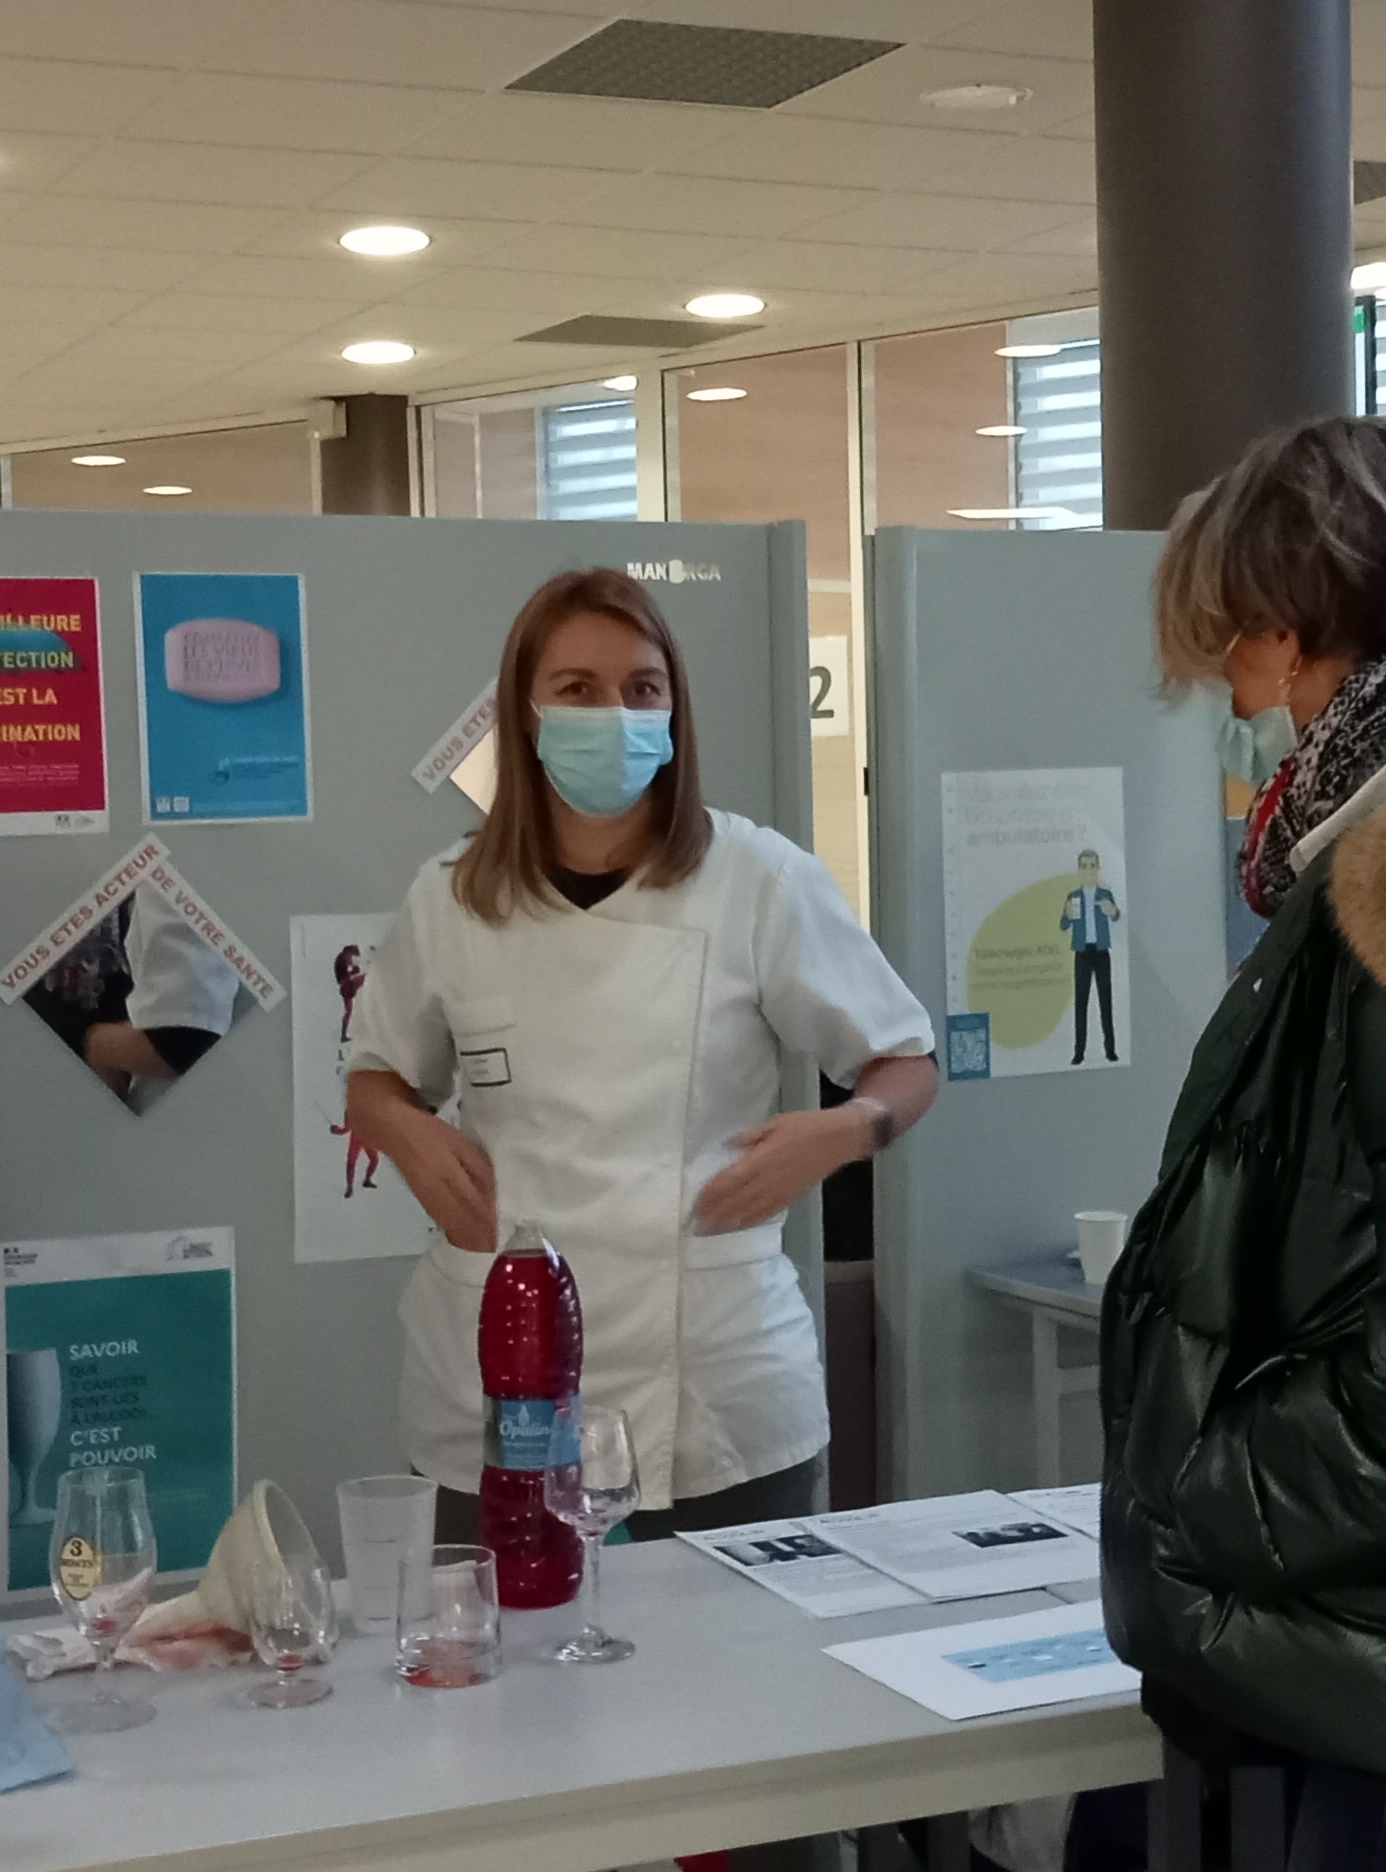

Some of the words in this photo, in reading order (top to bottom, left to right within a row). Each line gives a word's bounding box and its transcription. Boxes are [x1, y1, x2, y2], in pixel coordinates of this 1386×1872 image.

[32, 687, 58, 706] LA
[809, 666, 835, 719] 2
[0, 944, 51, 991] VOUS
[49, 905, 94, 947] ETES
[93, 843, 160, 909] ACTEUR
[149, 865, 176, 894] DE
[174, 893, 226, 946] VOTRE
[222, 944, 275, 1000] SANTE
[69, 1339, 139, 1361] SAVOIR
[70, 1426, 122, 1447] C'EST
[69, 1443, 157, 1468] POUVOIR
[70, 1540, 82, 1557] 3
